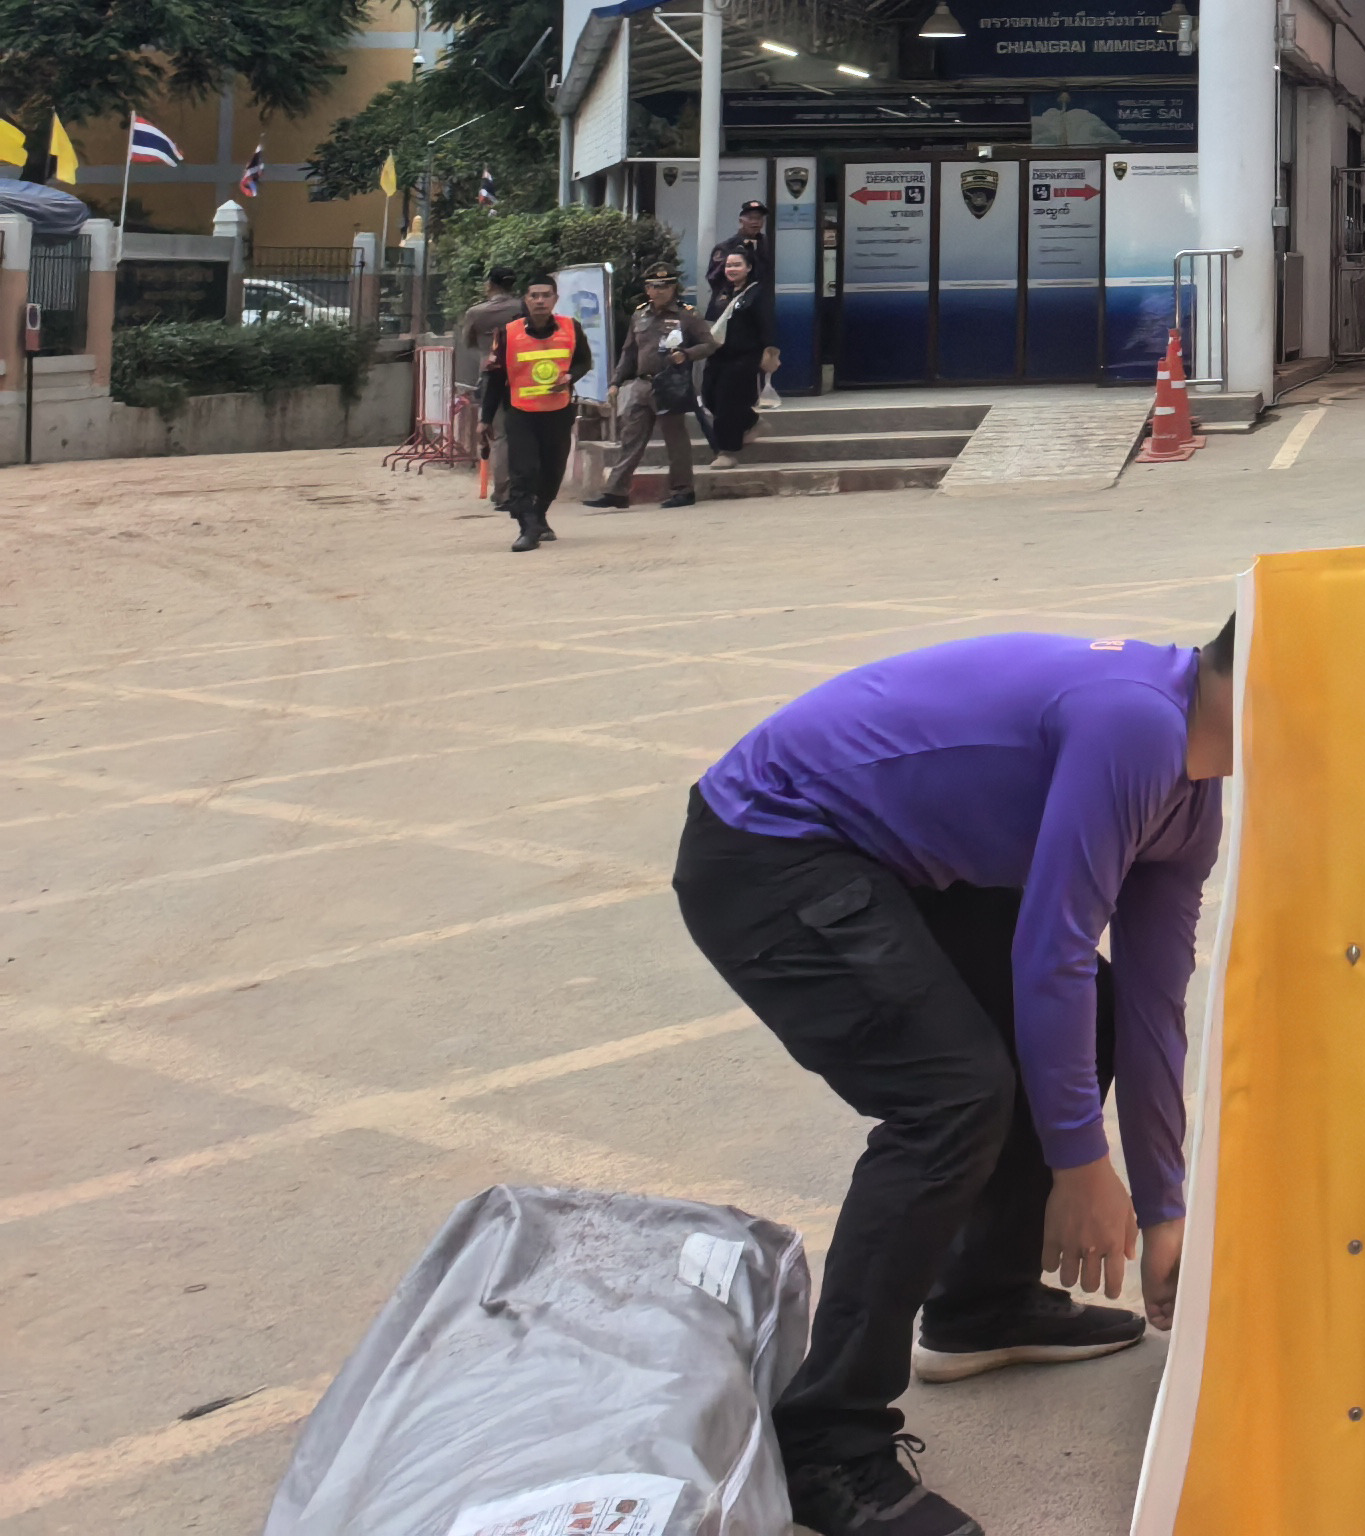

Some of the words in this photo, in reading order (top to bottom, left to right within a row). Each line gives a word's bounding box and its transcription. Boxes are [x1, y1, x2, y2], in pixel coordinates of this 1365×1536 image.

[979, 10, 1160, 29] ตรวจคนเข้าเมืองจังหวัดเ
[996, 39, 1086, 55] CHIANGRAI
[1092, 38, 1178, 54] IMMIGRAT
[1117, 109, 1152, 120] MAE
[1157, 109, 1183, 120] SAI
[866, 175, 926, 184] DEPARTURE
[1032, 172, 1086, 181] DEPARTURE
